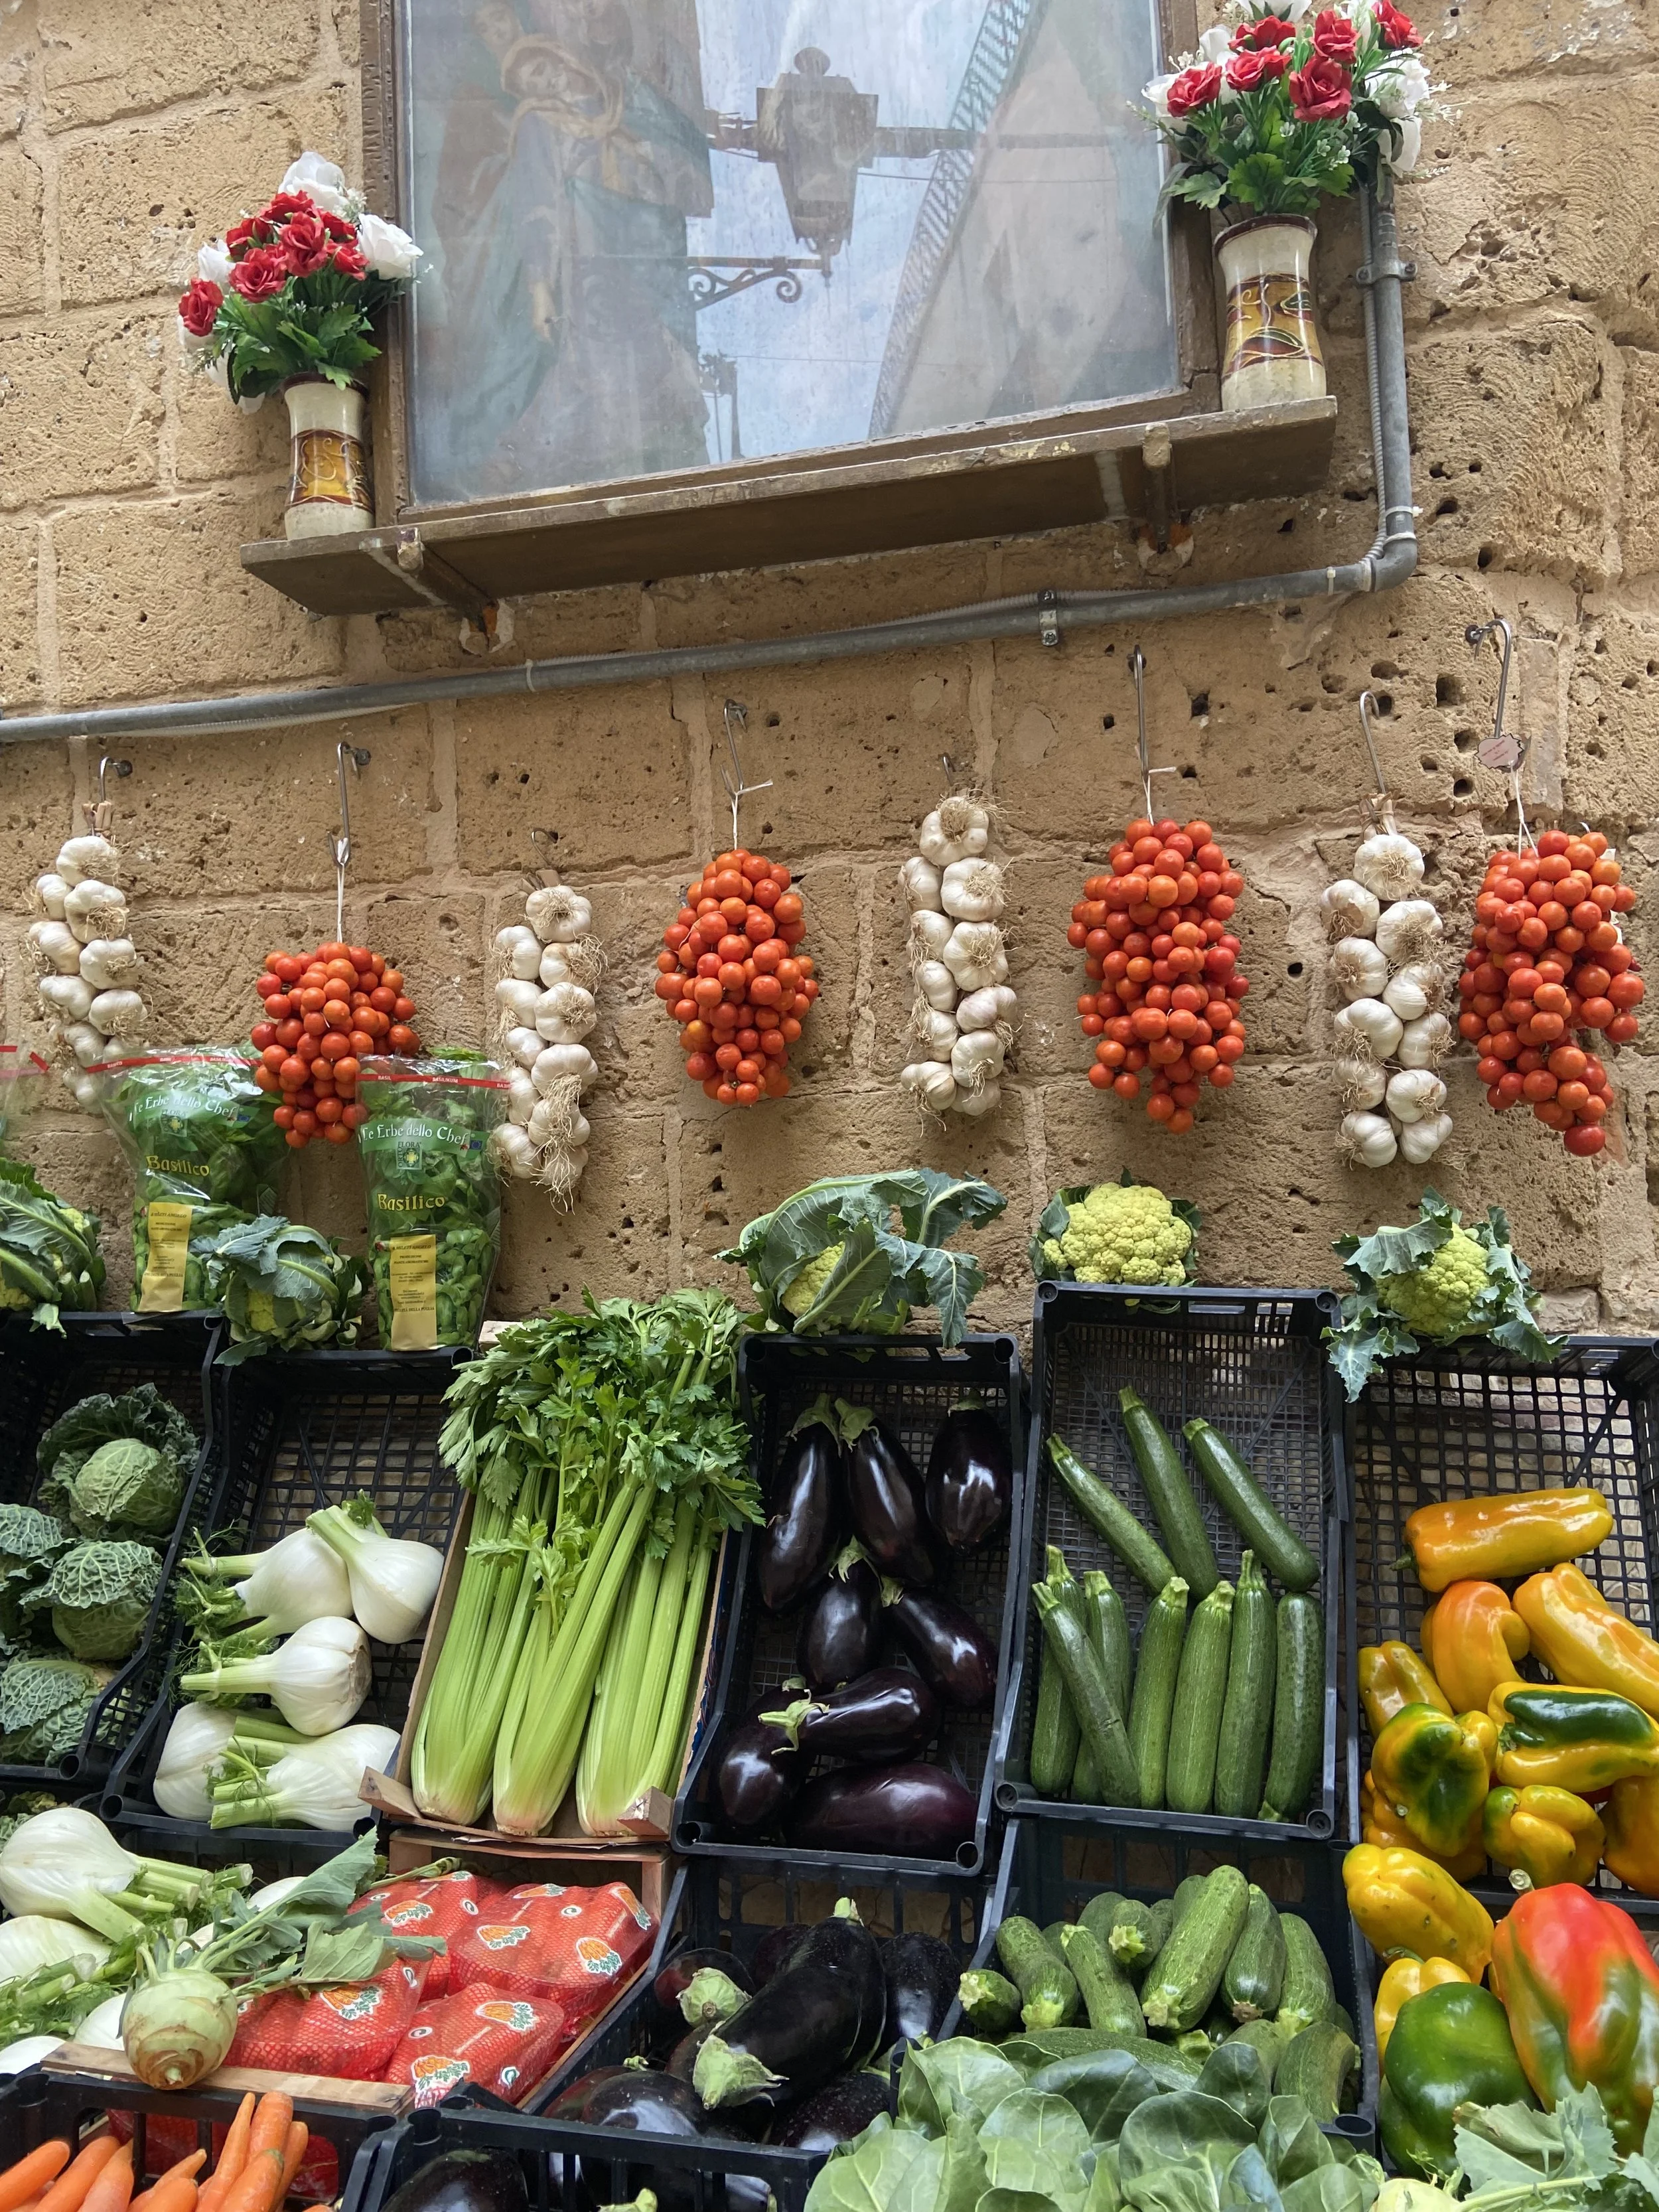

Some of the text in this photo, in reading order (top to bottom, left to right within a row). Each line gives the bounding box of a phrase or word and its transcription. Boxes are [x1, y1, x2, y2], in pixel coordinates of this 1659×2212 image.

[205, 1100, 238, 1117] Chef
[377, 1124, 404, 1139] Erbe
[406, 1123, 433, 1138] dello
[437, 1126, 469, 1145] Chef
[145, 1155, 210, 1177] Basilico
[377, 1193, 445, 1212] Basilico
